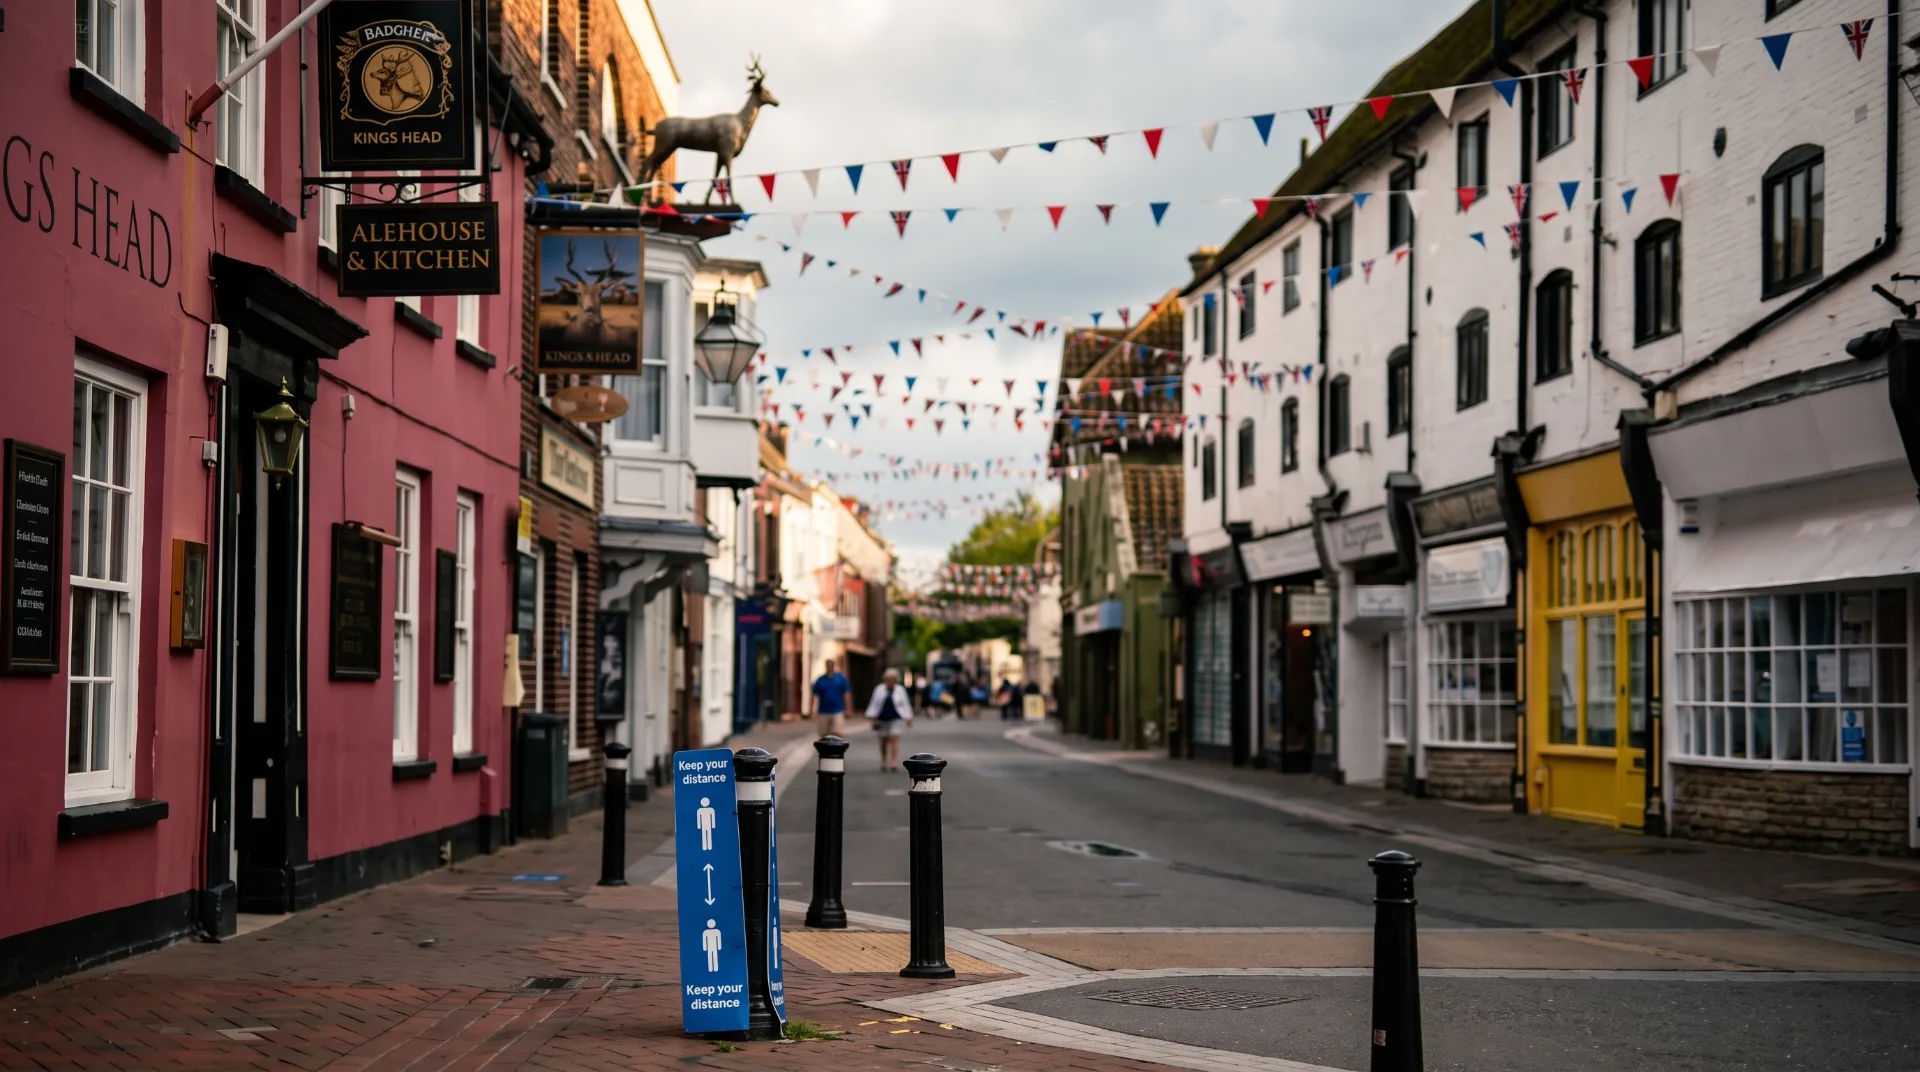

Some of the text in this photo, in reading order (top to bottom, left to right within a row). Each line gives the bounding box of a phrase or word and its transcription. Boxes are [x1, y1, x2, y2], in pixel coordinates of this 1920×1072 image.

[353, 131, 443, 145] KINGS HEAD
[72, 166, 172, 288] HEAD
[351, 221, 486, 243] ALEHOUSE
[346, 249, 490, 271] & KITCHEN
[678, 759, 728, 772] Keep your
[682, 774, 726, 785] distance
[686, 984, 743, 998] Keep your
[691, 998, 740, 1010] distance
